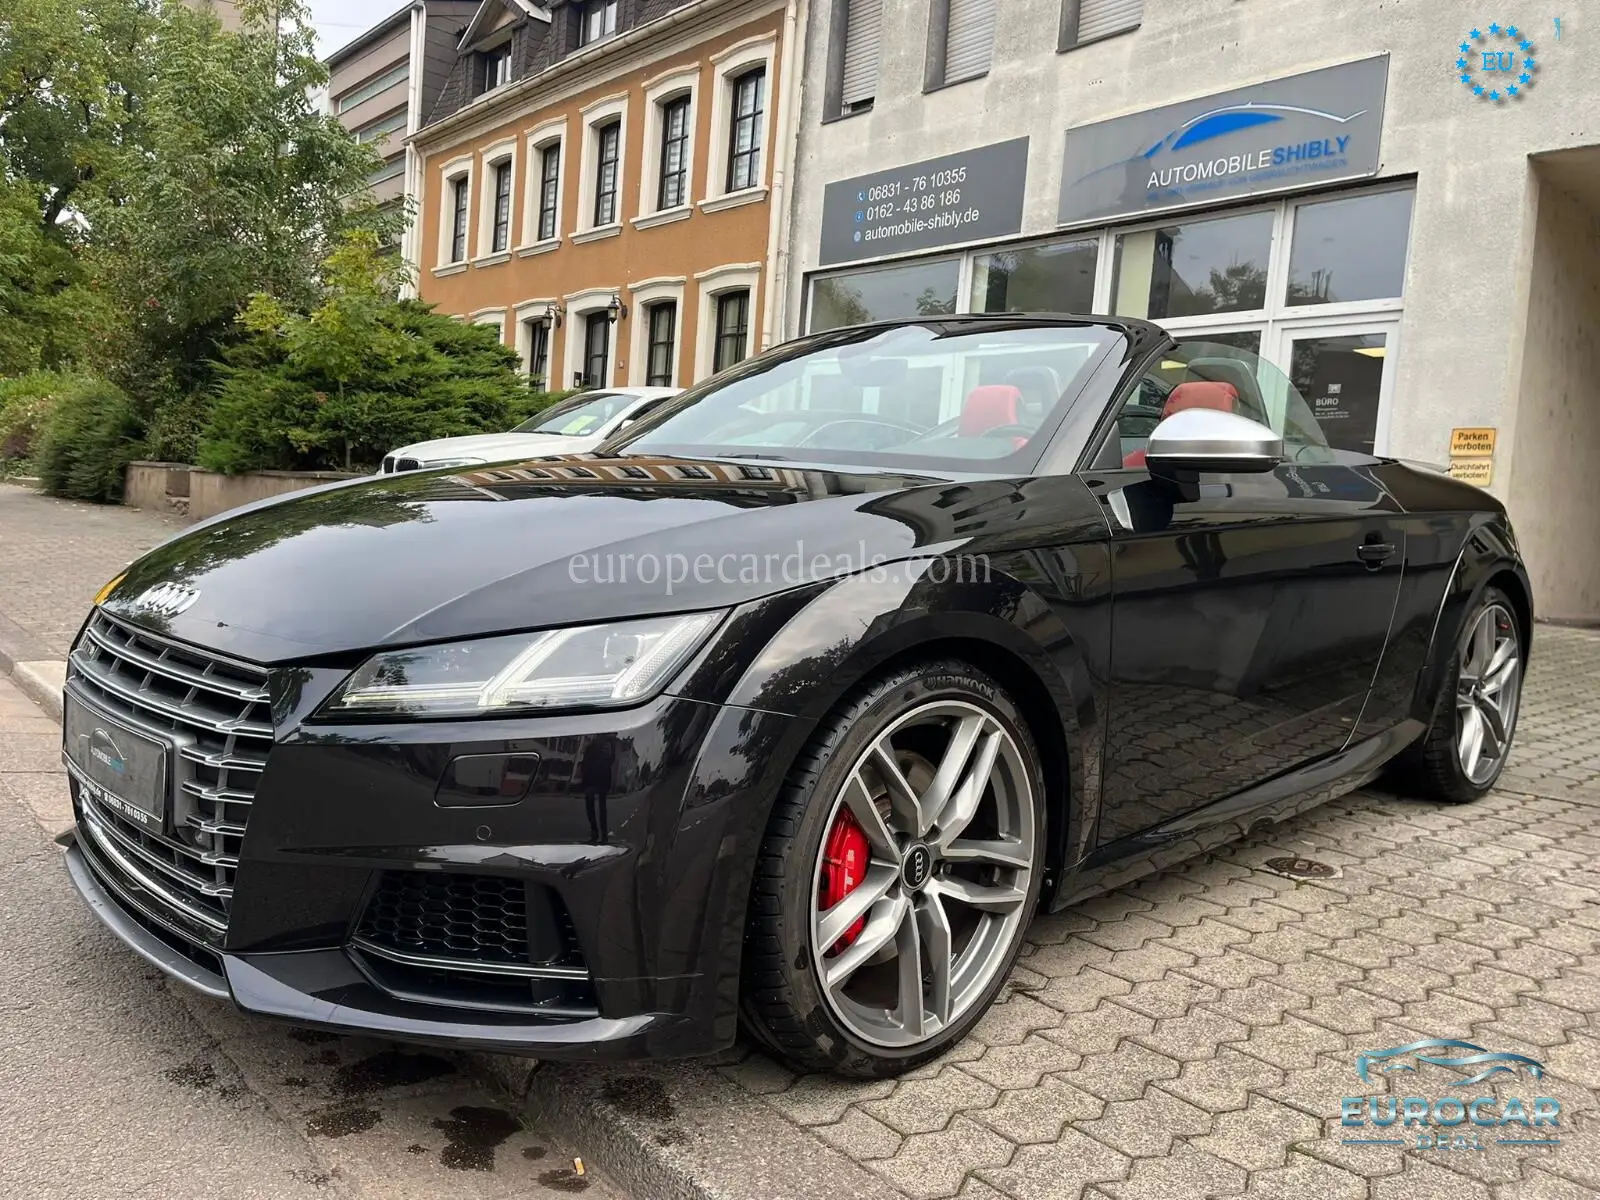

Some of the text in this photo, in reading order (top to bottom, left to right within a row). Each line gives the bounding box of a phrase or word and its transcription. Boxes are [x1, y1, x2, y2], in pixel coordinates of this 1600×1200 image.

[868, 181, 901, 202] 06831
[912, 175, 927, 192] 76
[930, 166, 967, 190] 10355
[866, 202, 894, 221] 0162
[903, 197, 918, 214] 43
[920, 193, 935, 210] 86
[939, 188, 961, 207] 186
[864, 207, 980, 240] automobile-shibly.de
[1453, 442, 1492, 450] verboten
[1457, 432, 1489, 441] Parken
